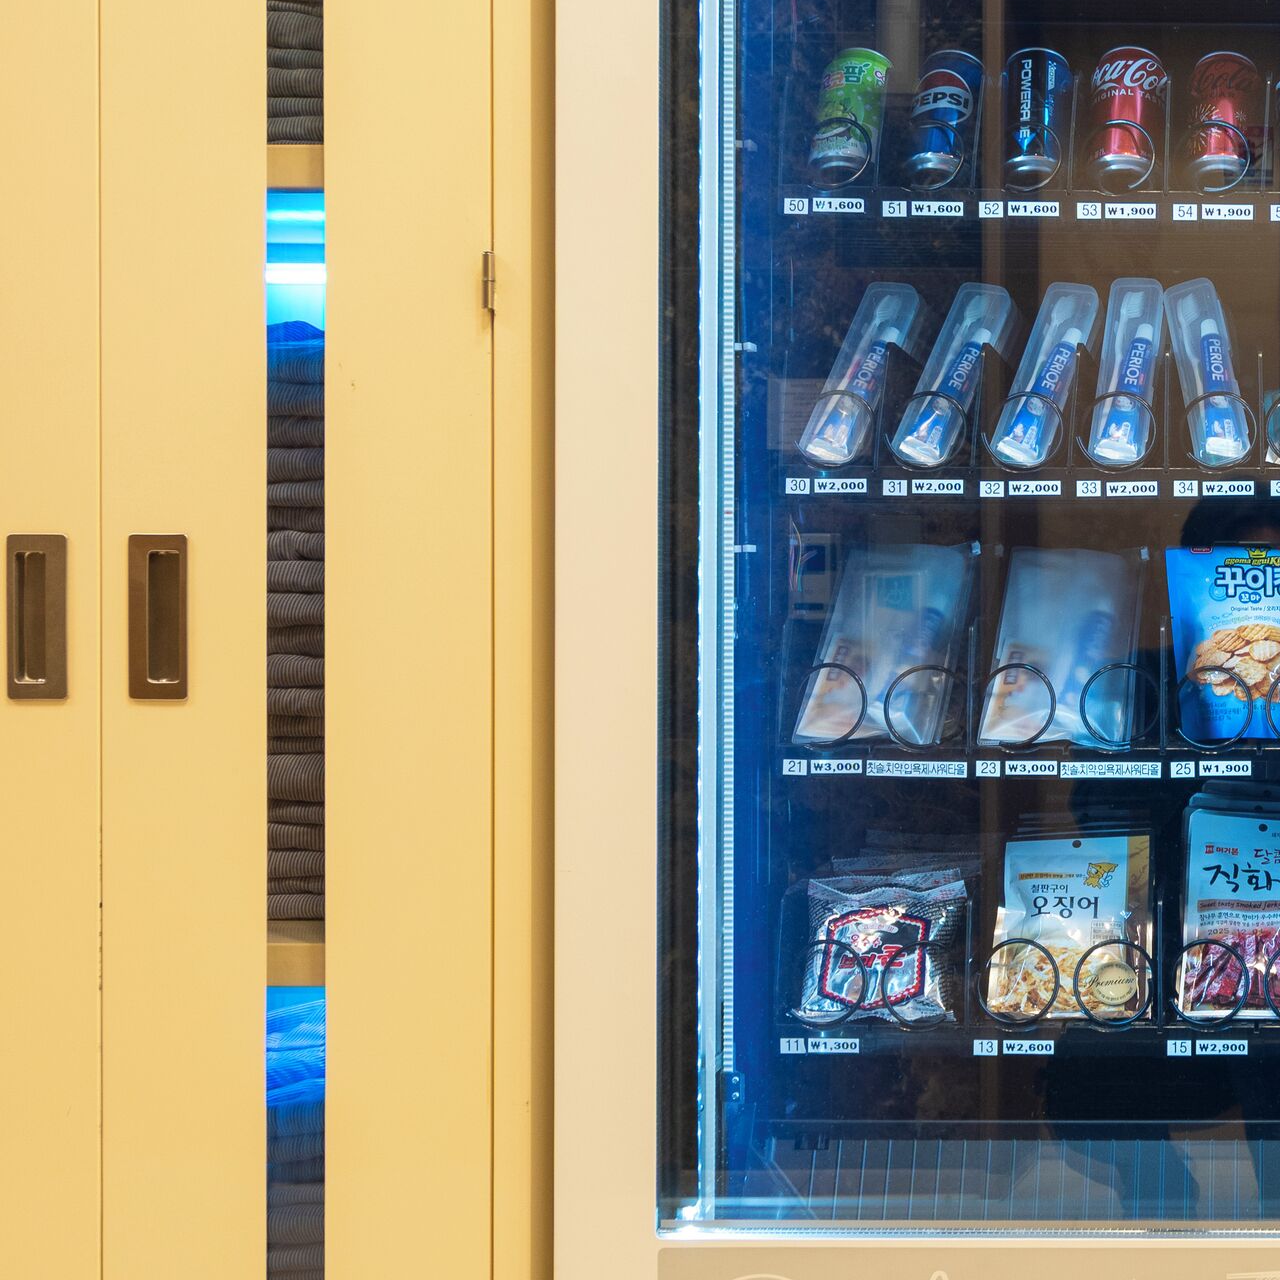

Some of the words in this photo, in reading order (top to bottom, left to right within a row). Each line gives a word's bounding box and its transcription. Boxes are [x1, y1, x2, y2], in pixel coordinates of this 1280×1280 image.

[788, 199, 805, 212] 50
[1081, 204, 1097, 216] 53
[1124, 343, 1146, 386] PERIOE
[1208, 338, 1225, 382] PERIOE
[948, 346, 981, 392] PERIOE
[790, 479, 806, 492] 30
[1081, 482, 1097, 494] 33
[1240, 592, 1260, 603] 꼬마
[788, 761, 803, 773] 21
[1175, 762, 1192, 775] 25
[1203, 862, 1280, 894] 직화
[1031, 895, 1100, 919] 오징어
[1085, 973, 1135, 991] Premium
[786, 1039, 801, 1052] 11
[978, 1041, 994, 1053] 13
[1172, 1041, 1188, 1054] 15
